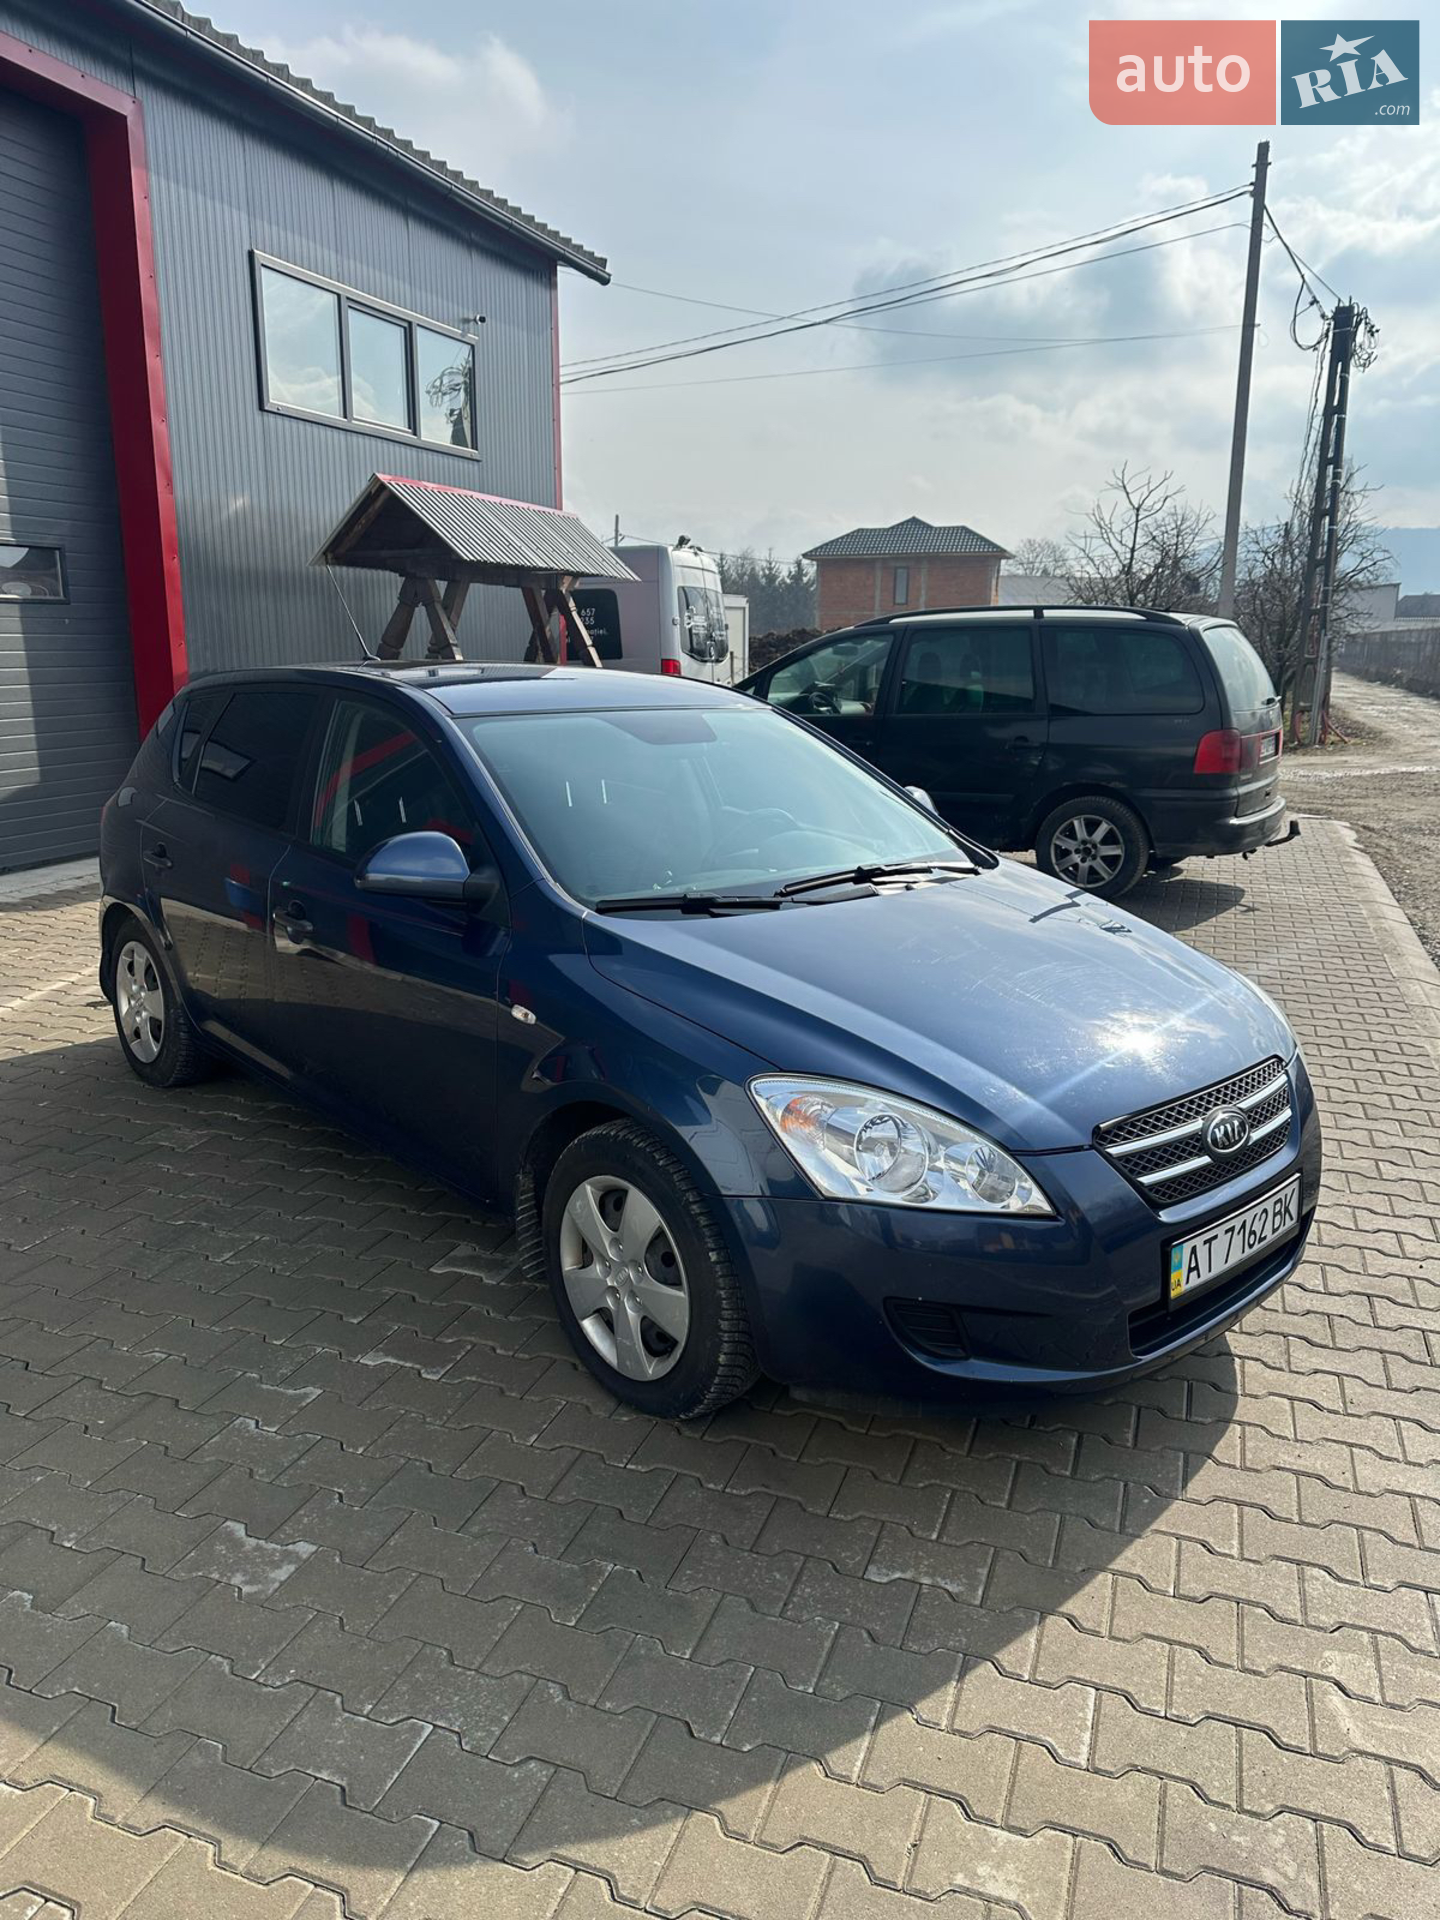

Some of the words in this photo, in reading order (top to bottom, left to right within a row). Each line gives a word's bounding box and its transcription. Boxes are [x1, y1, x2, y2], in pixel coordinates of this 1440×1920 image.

[1213, 1120, 1244, 1148] KIA
[1185, 1234, 1219, 1285] AT
[1224, 1207, 1269, 1264] 7162
[1271, 1187, 1296, 1235] BK
